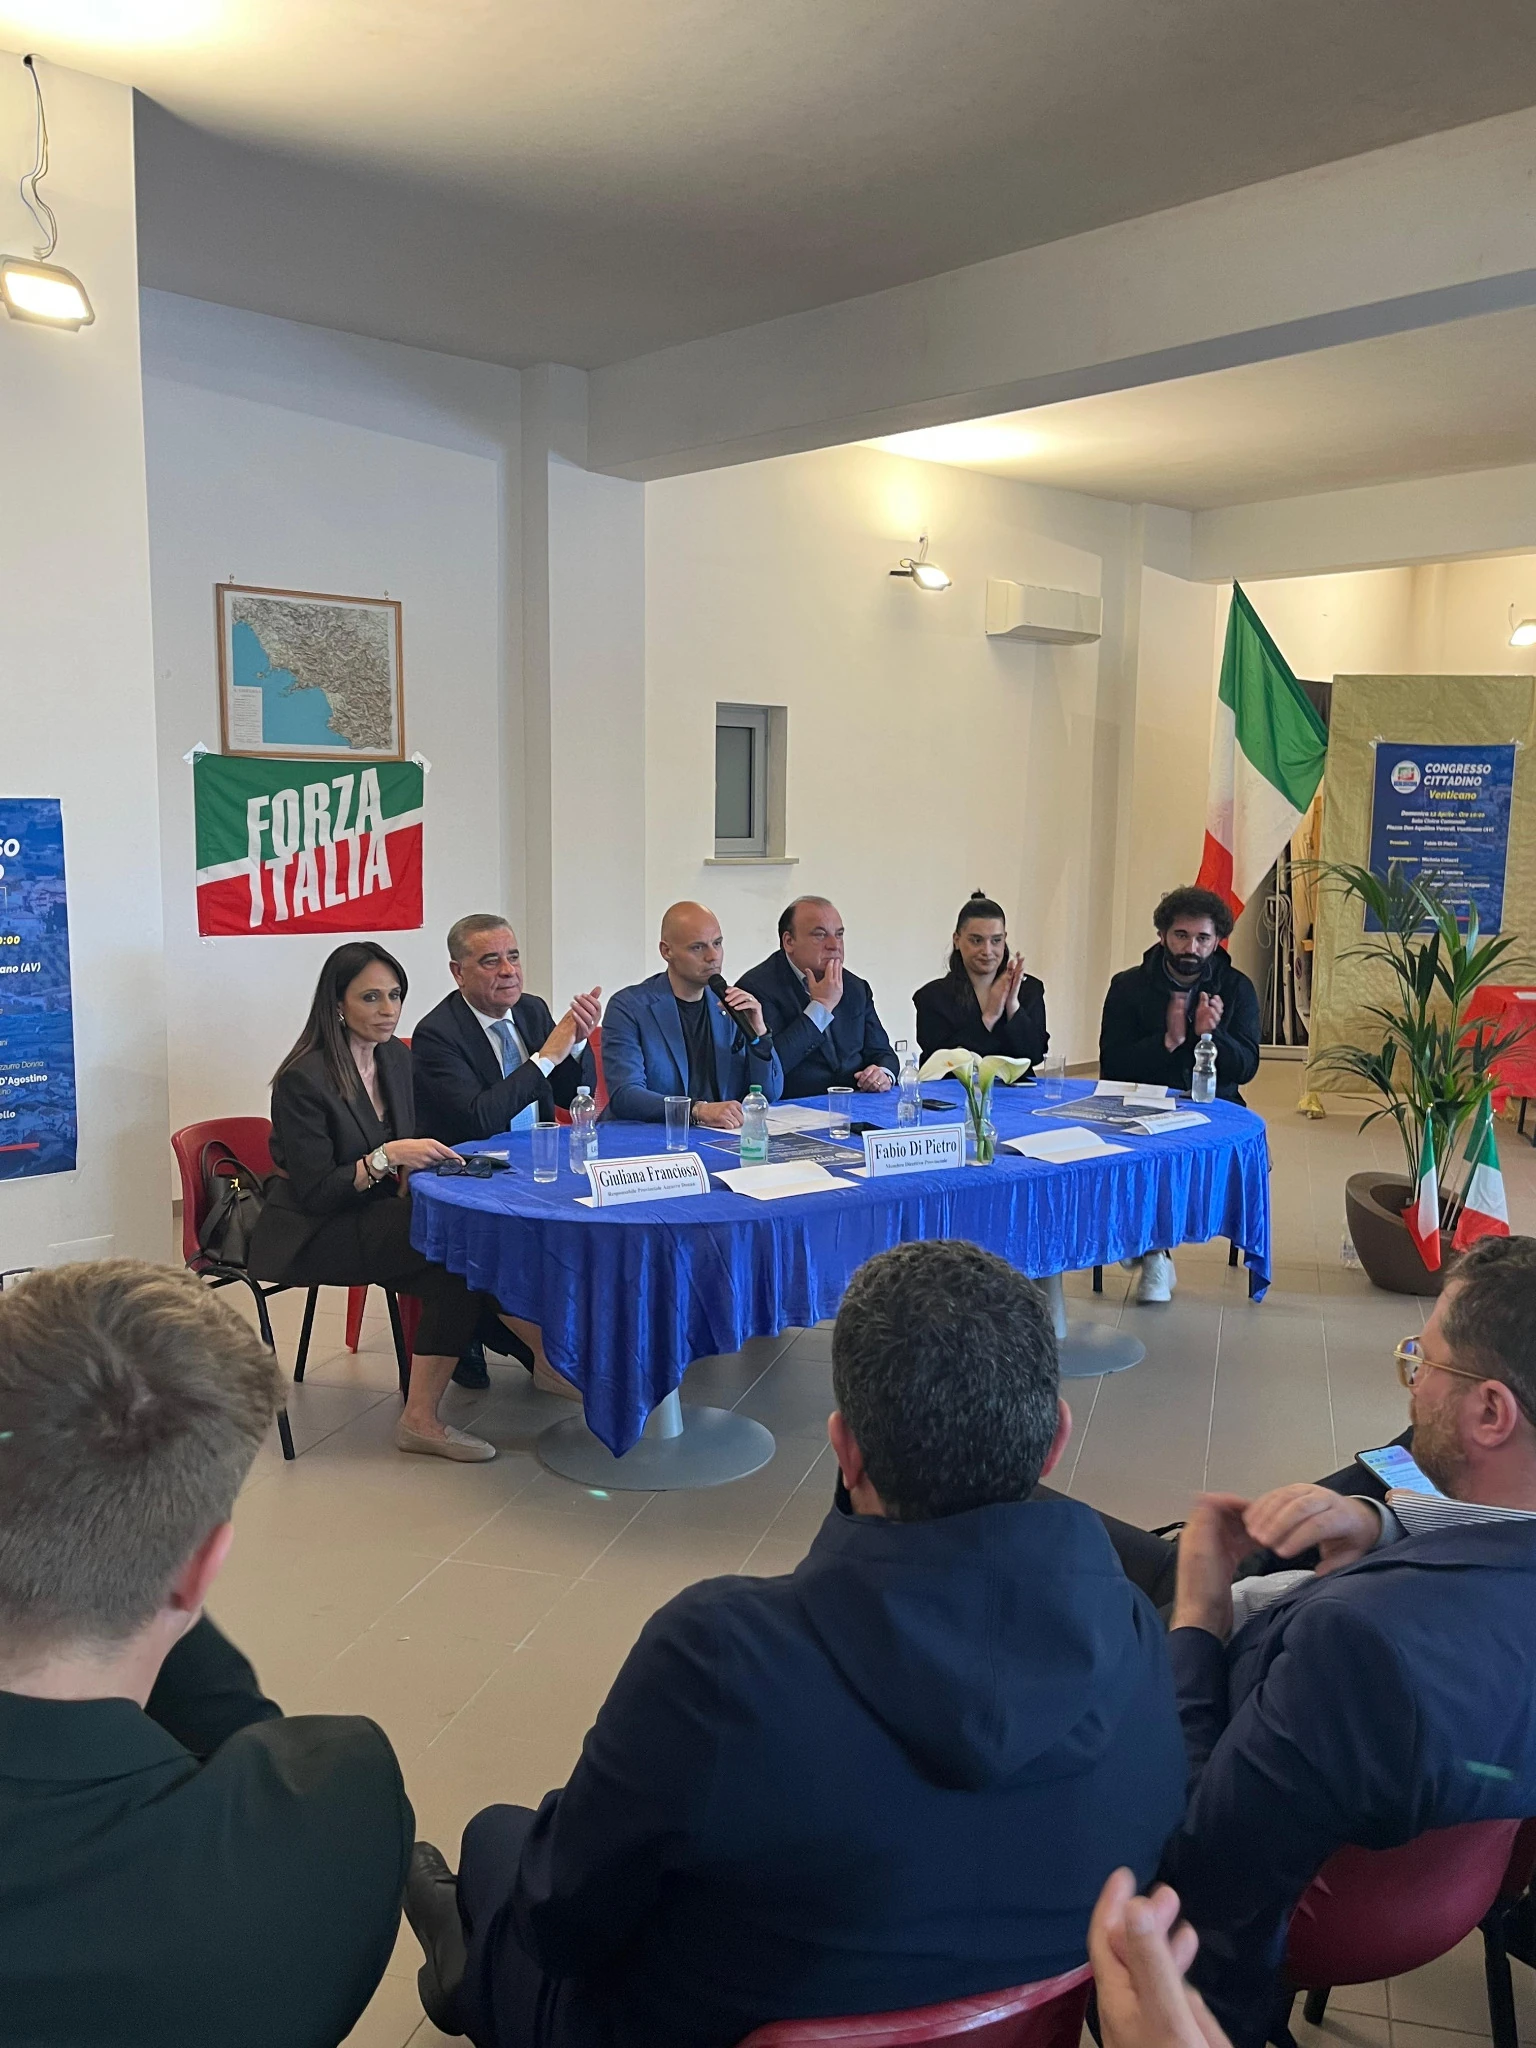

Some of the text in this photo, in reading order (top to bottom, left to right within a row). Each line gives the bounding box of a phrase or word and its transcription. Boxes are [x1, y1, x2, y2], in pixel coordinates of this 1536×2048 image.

[1425, 763, 1491, 774] CONGRESSO
[1424, 775, 1482, 786] CITTADINO
[1429, 789, 1477, 800] Venticano
[247, 768, 384, 862] FORZA
[248, 833, 392, 928] ITALIA
[20, 962, 41, 973] (AV)
[0, 1074, 48, 1086] D'Agostino
[875, 1138, 957, 1160] Fabio Di Pietro
[599, 1163, 698, 1188] Giuliana Franciosa
